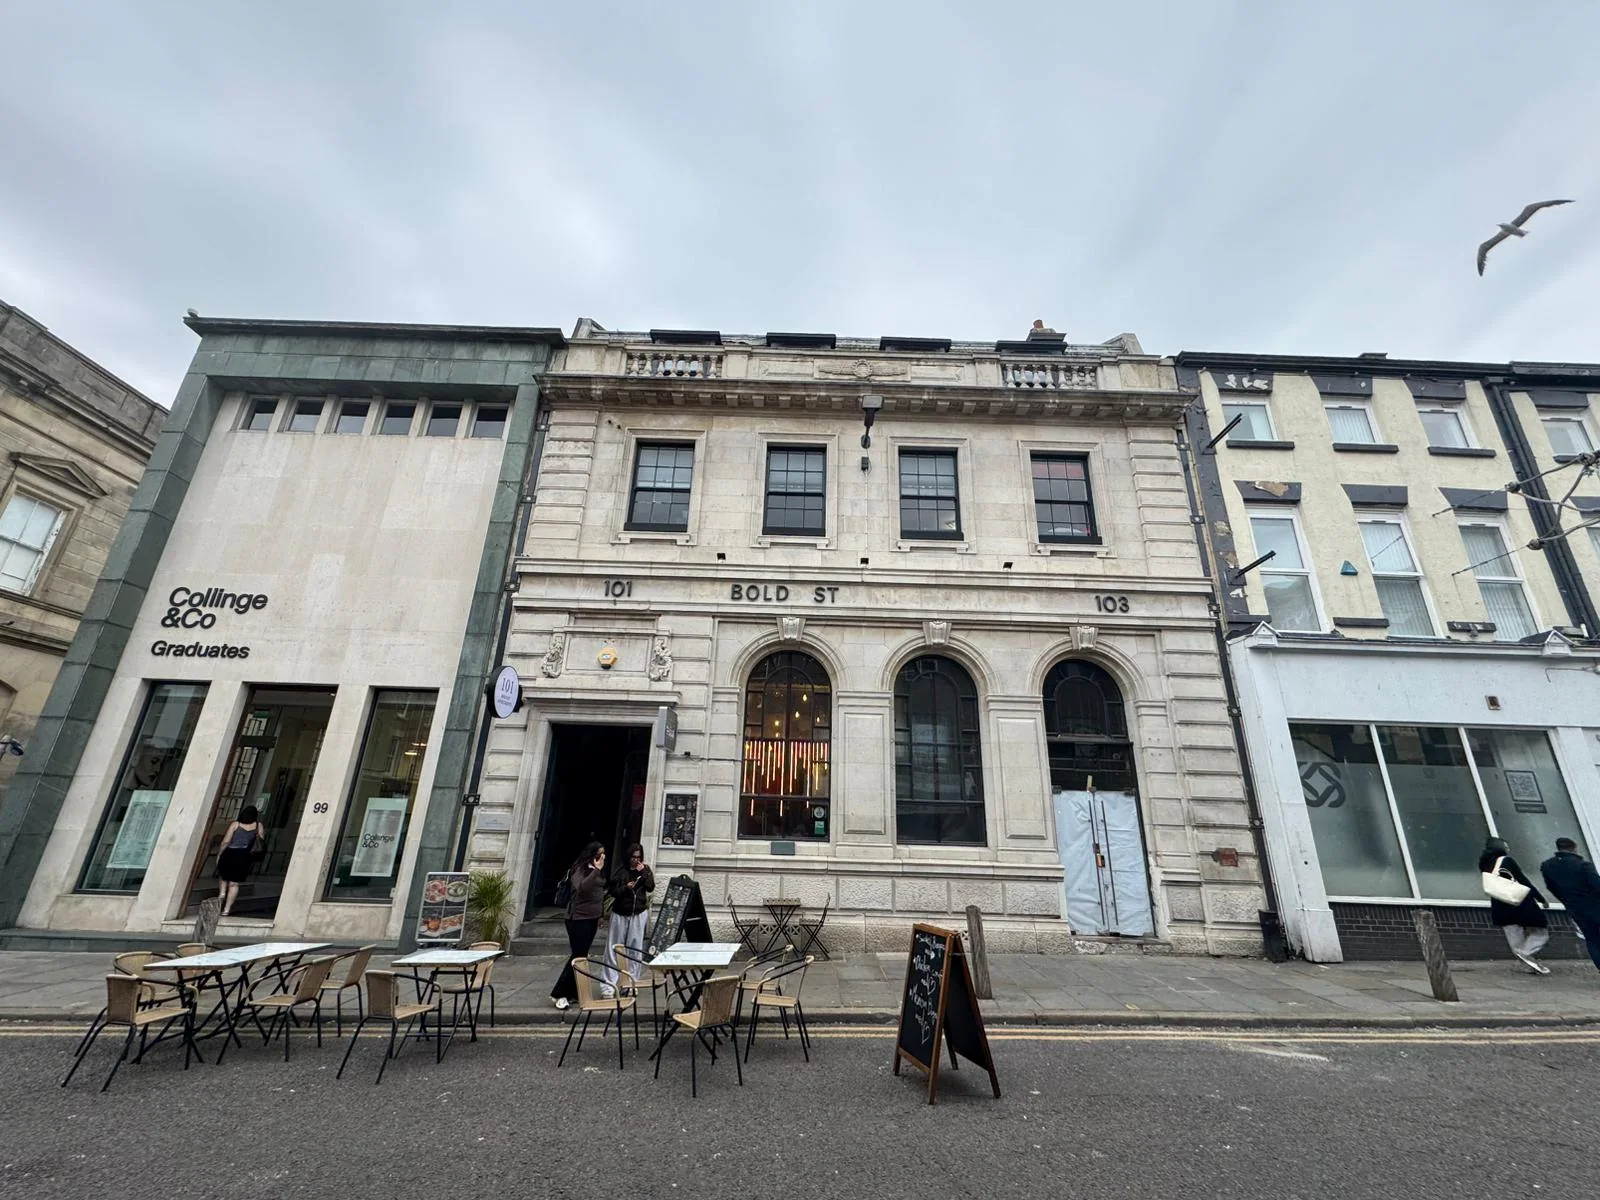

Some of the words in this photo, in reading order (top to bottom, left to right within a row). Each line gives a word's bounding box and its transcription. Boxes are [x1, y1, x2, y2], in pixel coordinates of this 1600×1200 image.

[604, 580, 632, 598] 101
[731, 584, 789, 601] BOLD
[813, 586, 840, 603] ST
[169, 586, 269, 615] Collinge
[1095, 595, 1130, 613] 103
[160, 607, 217, 630] &Co
[150, 640, 251, 659] Graduates
[501, 678, 514, 695] 101
[313, 802, 329, 814] 99
